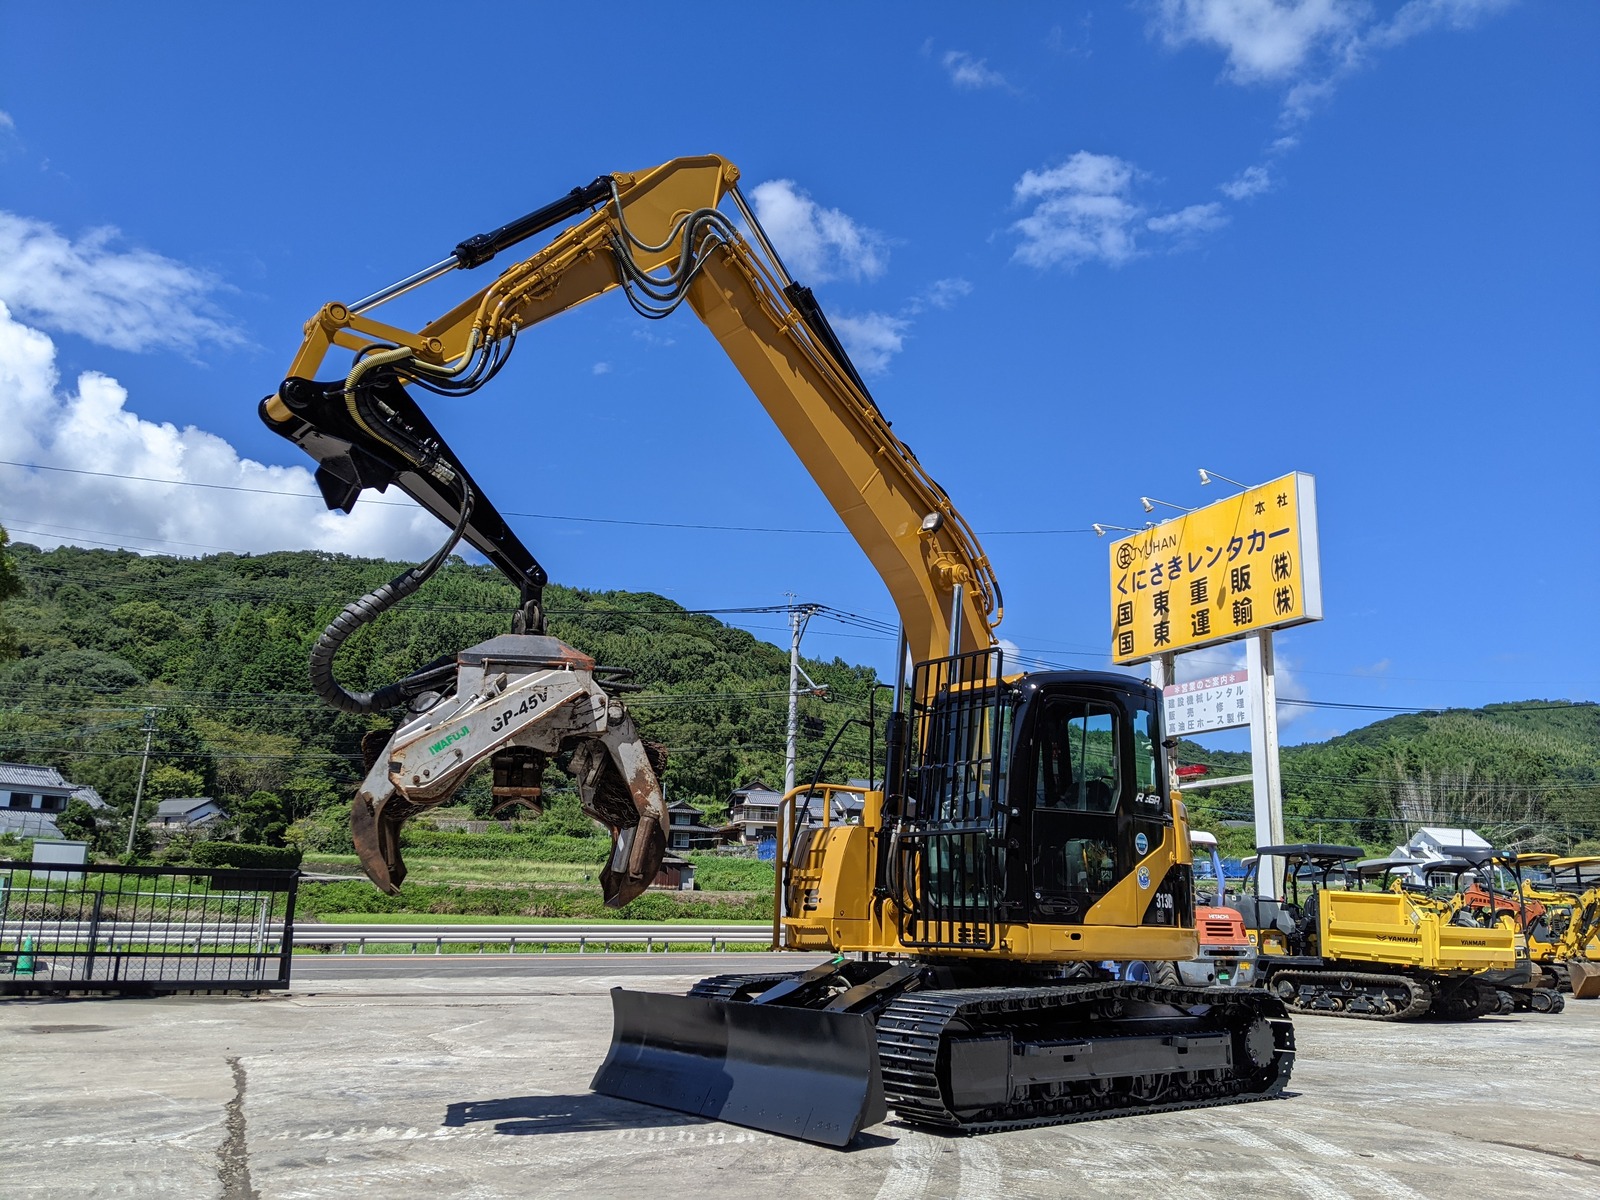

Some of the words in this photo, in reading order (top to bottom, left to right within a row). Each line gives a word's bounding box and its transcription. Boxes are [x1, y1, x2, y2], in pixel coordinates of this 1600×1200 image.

[1254, 493, 1288, 515] 本社
[1117, 528, 1290, 594] くにさきレンタカー
[1168, 686, 1244, 708] 建設機械レンタル
[491, 687, 548, 732] GP-45V
[428, 725, 470, 755] IWAFUJI
[1156, 893, 1173, 909] 313D
[1388, 935, 1419, 943] YANMAR
